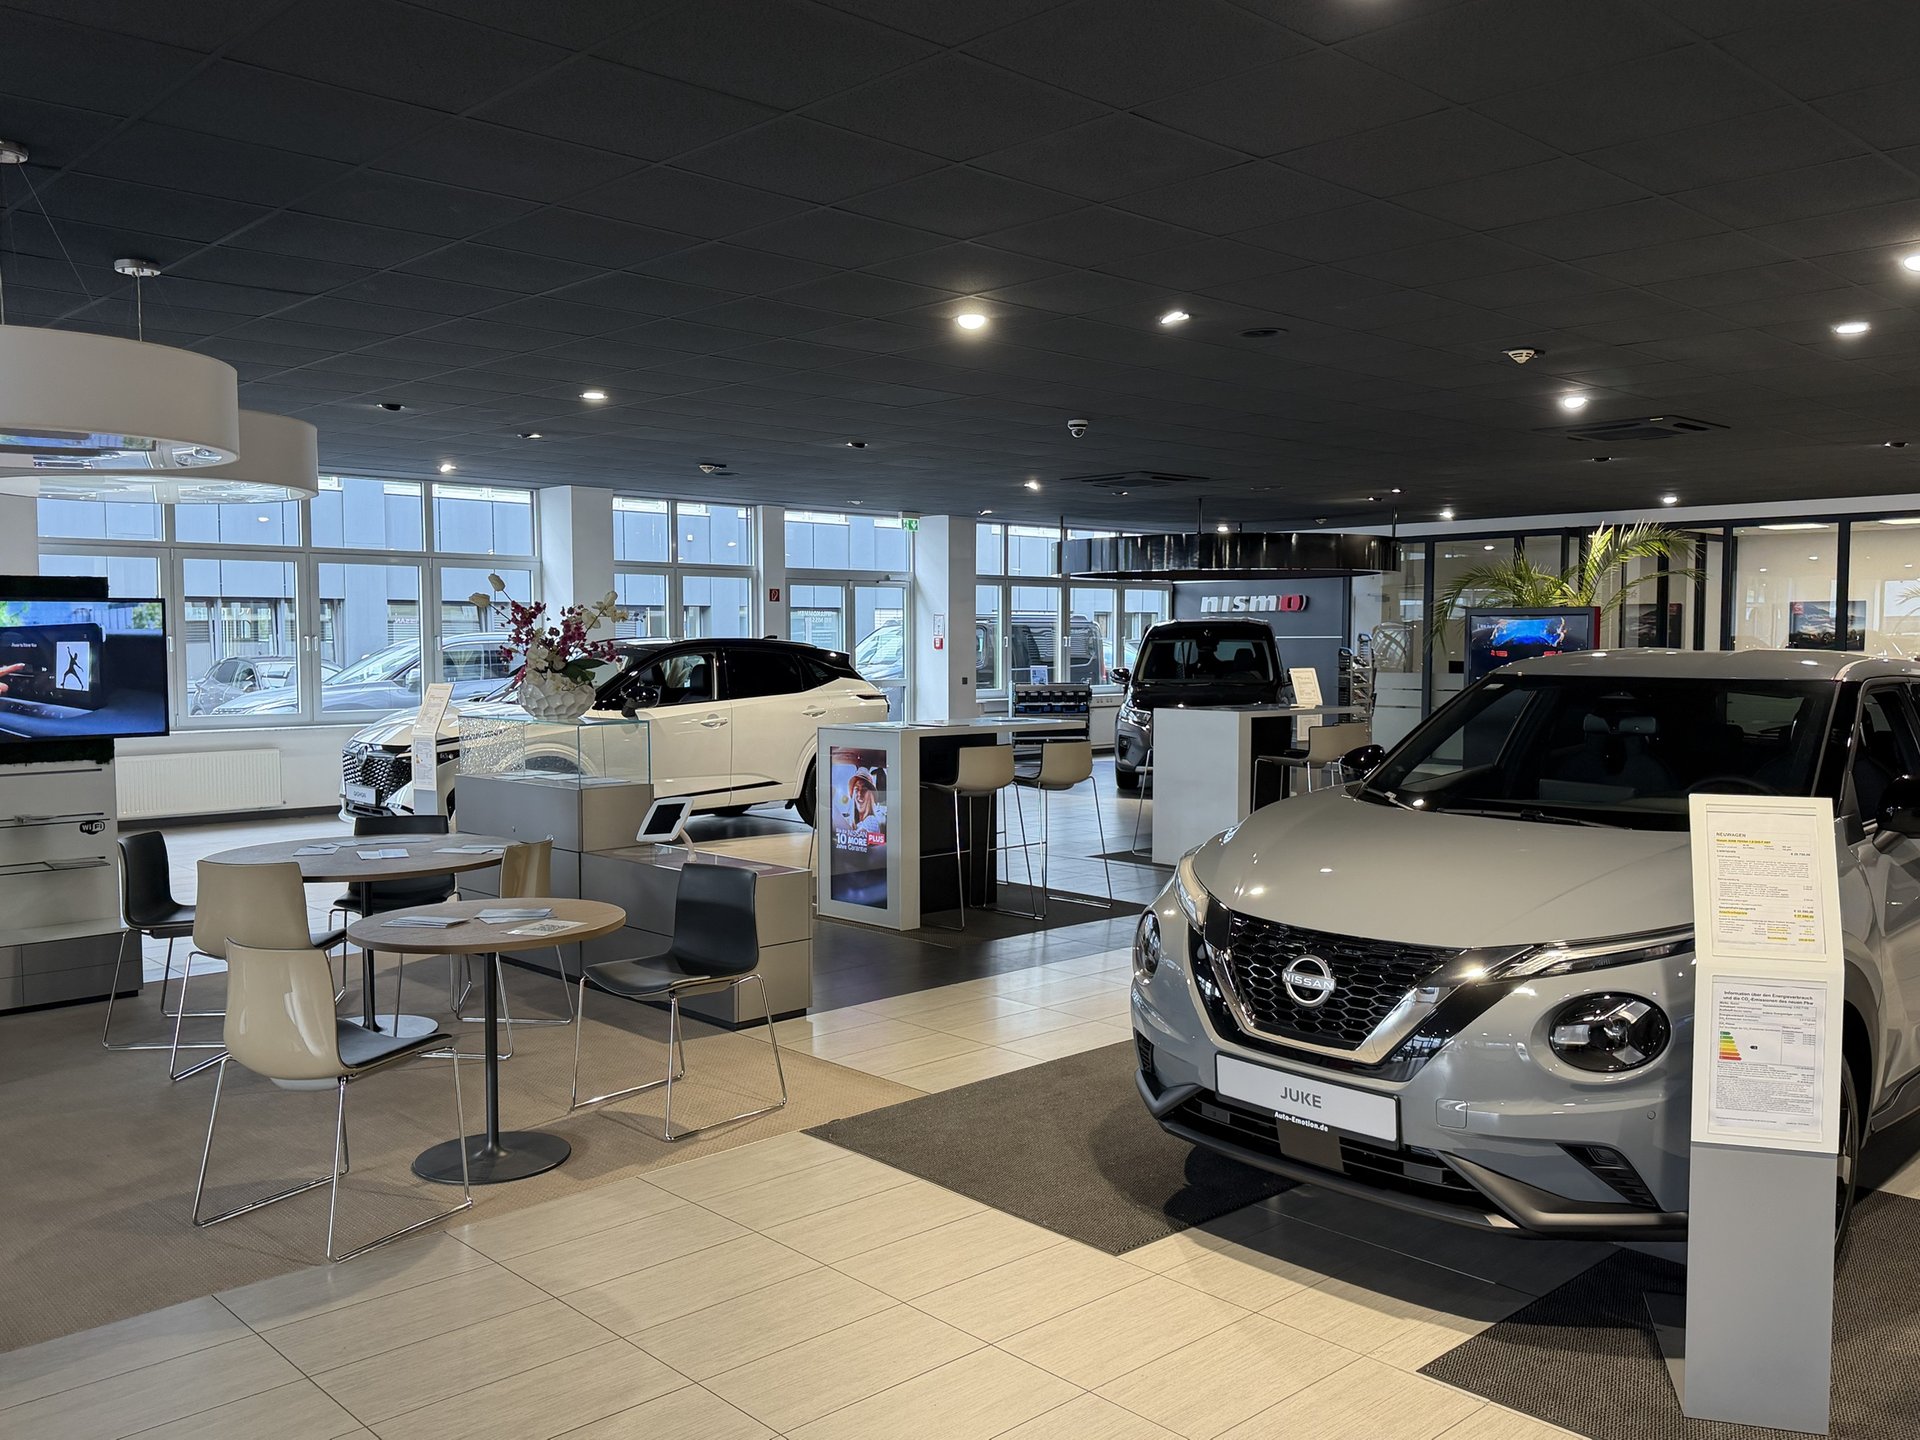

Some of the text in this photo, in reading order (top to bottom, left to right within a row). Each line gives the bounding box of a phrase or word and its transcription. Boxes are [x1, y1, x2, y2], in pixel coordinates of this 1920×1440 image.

[1200, 594, 1306, 612] nismo
[835, 833, 885, 847] 10 MORE PLUS
[1283, 973, 1335, 990] NISSAN
[1280, 1086, 1322, 1109] JUKE
[1274, 1111, 1329, 1132] Auto-Emotion.de
